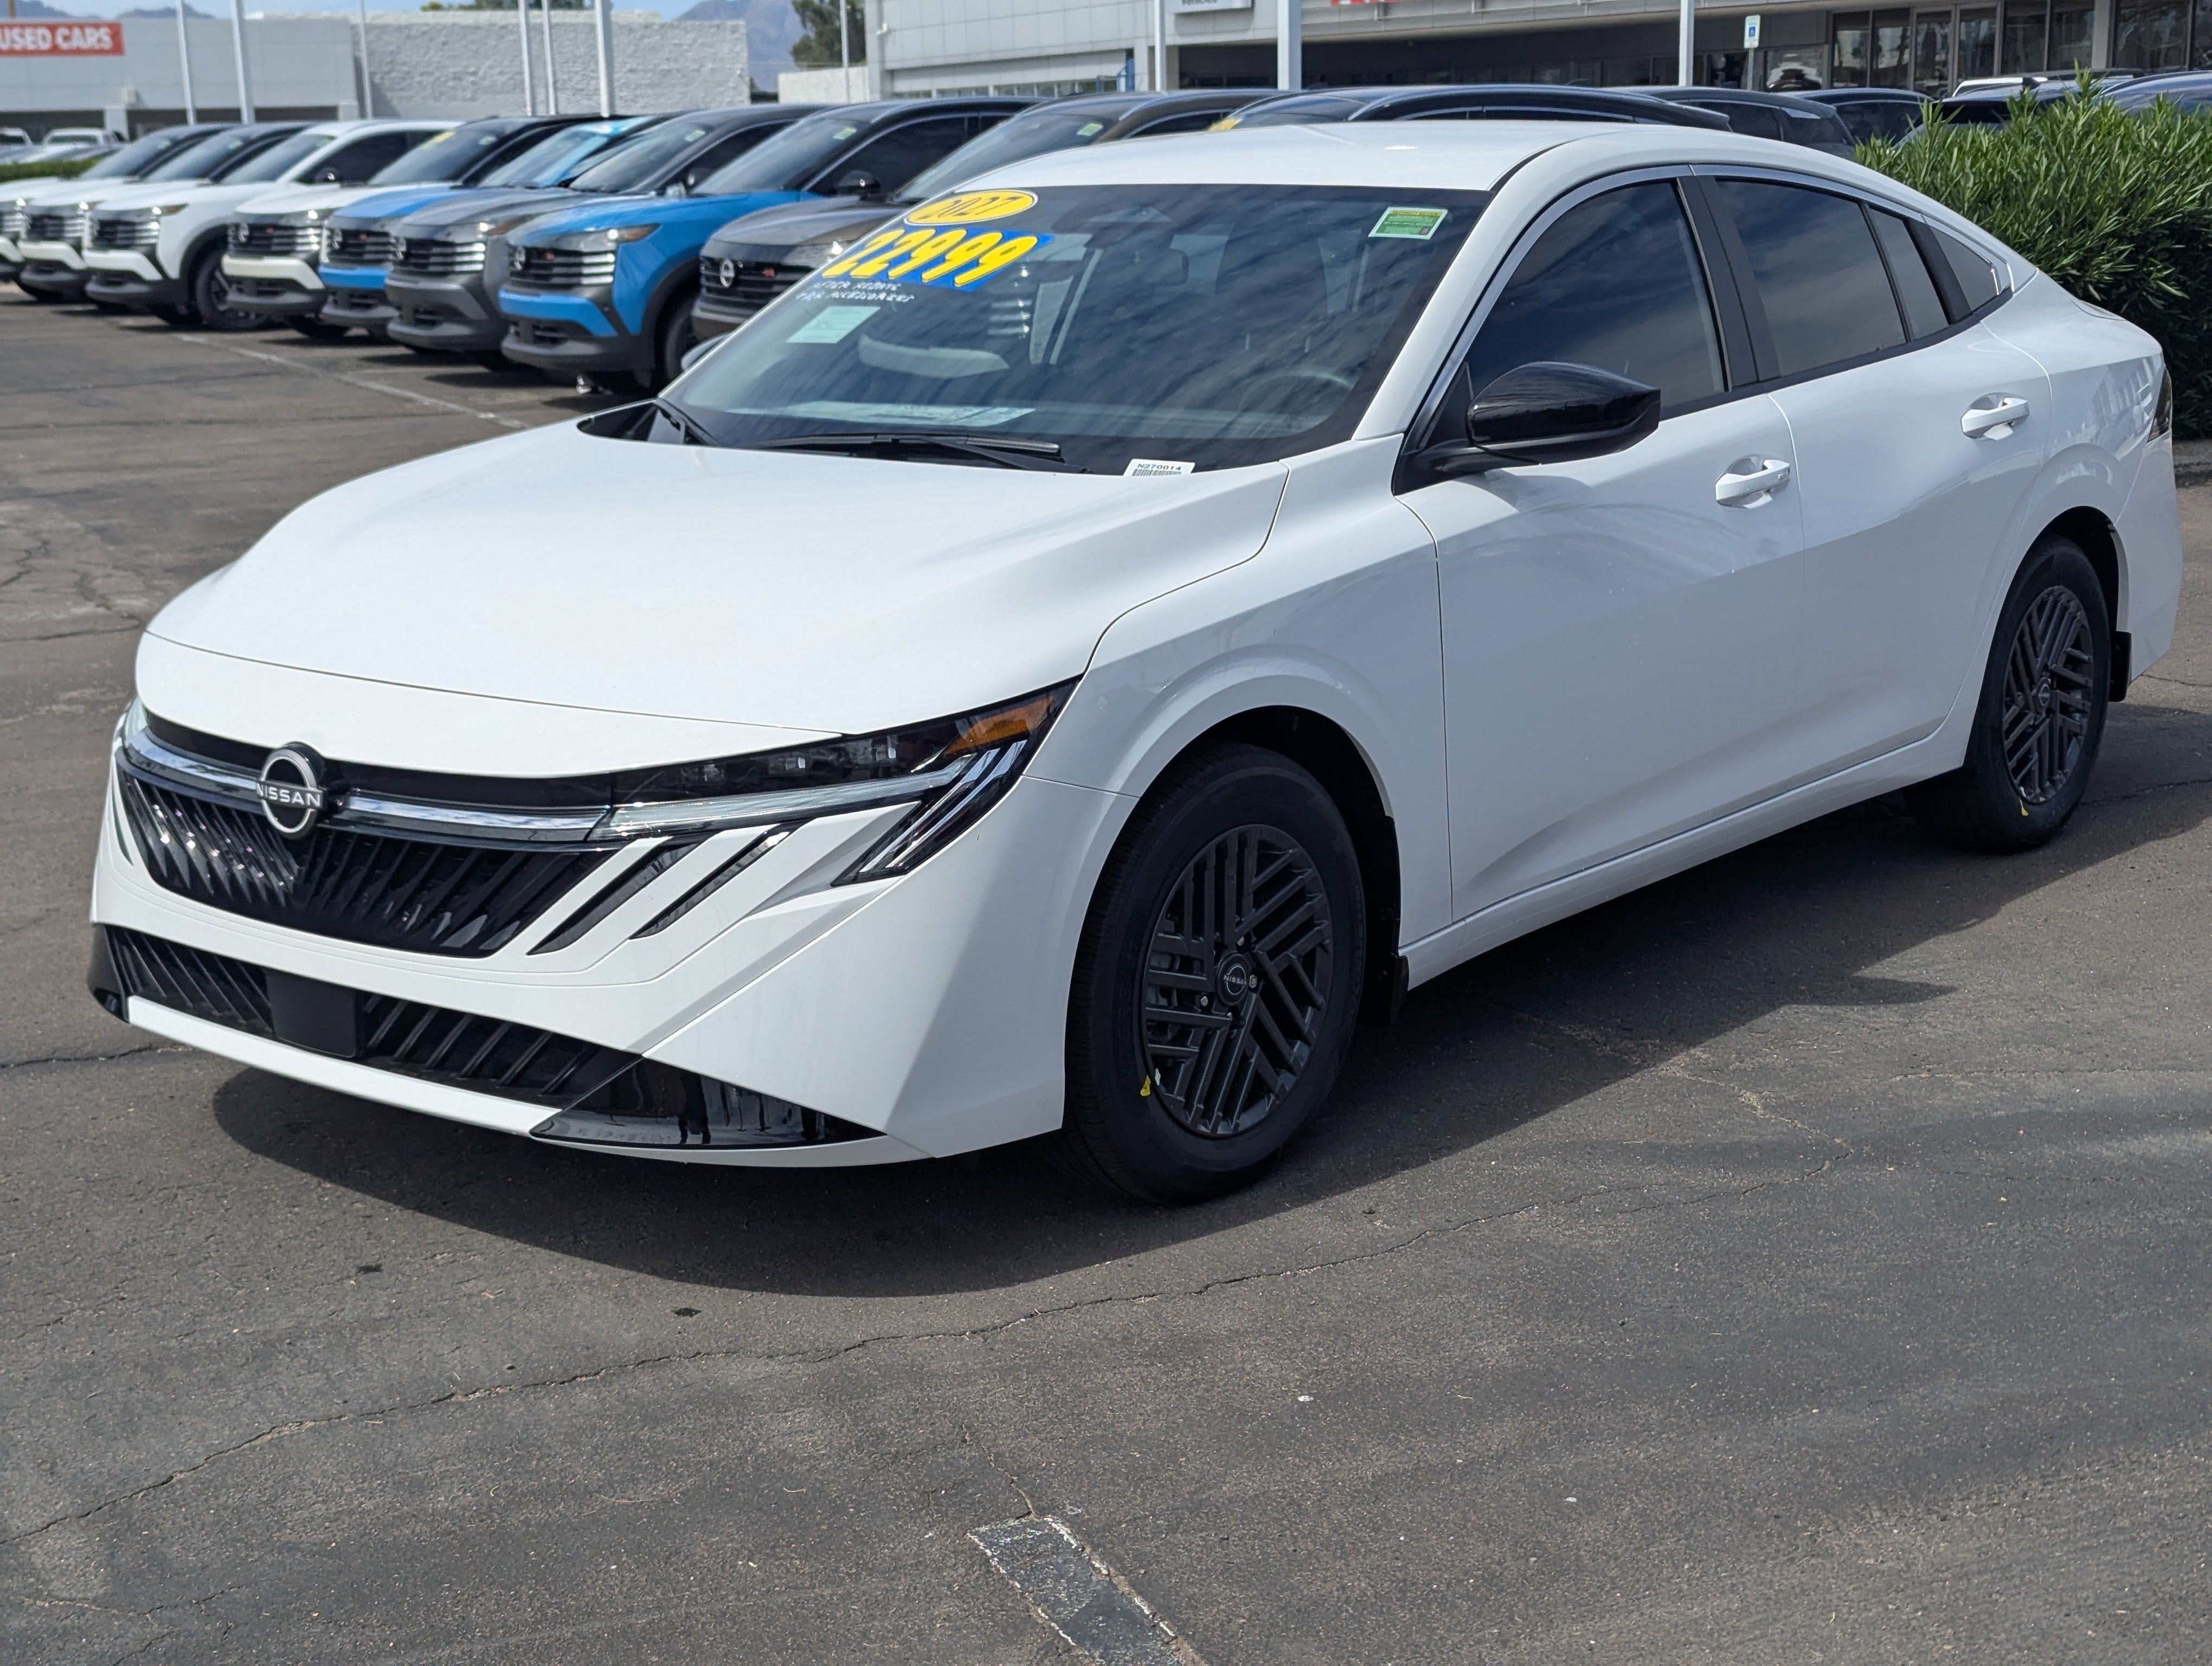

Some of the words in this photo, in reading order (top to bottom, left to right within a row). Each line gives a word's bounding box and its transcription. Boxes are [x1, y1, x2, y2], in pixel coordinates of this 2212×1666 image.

[0, 28, 52, 50] USED
[56, 27, 113, 50] CARS
[916, 196, 1024, 220] 2027
[821, 228, 1038, 287] 22999
[256, 783, 321, 807] NISSAN
[1223, 975, 1247, 985] NISSAN
